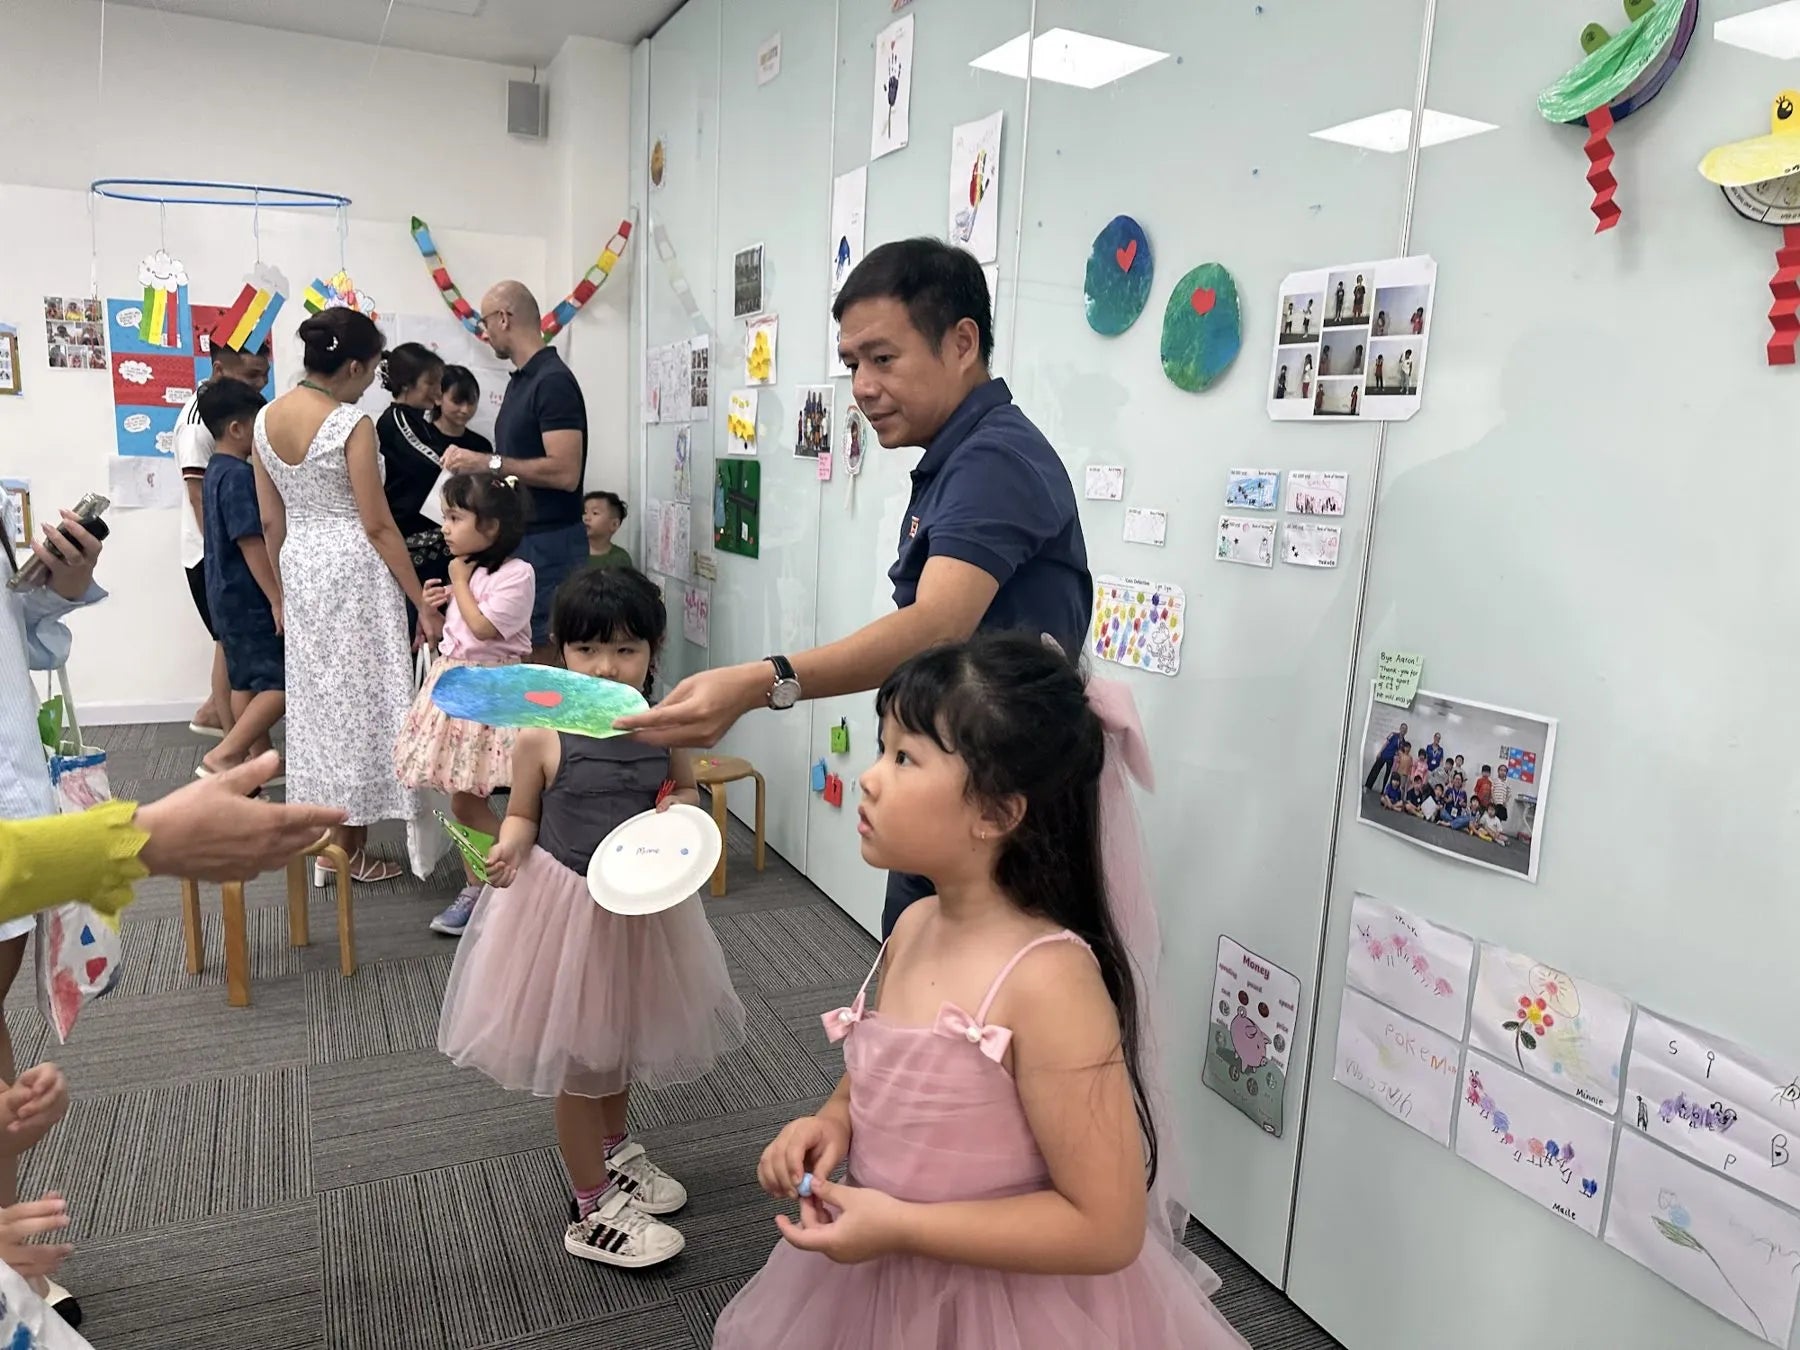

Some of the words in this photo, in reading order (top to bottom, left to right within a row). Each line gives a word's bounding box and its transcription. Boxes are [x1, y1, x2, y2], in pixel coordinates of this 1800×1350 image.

[1380, 651, 1392, 663] Bye
[1242, 954, 1270, 981] Money
[1575, 1088, 1604, 1107] Minnie
